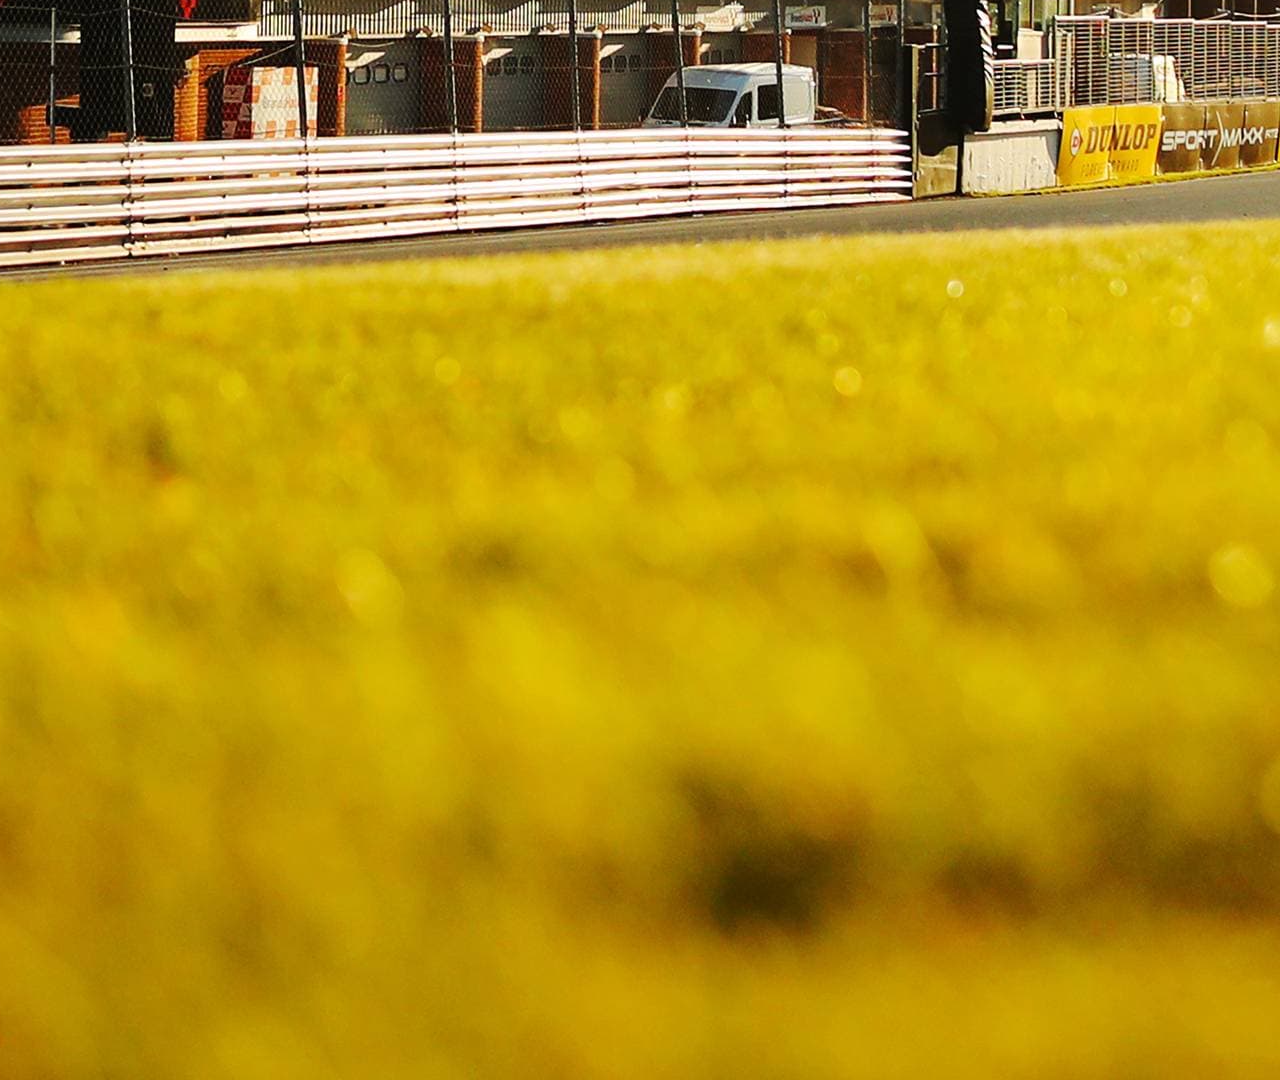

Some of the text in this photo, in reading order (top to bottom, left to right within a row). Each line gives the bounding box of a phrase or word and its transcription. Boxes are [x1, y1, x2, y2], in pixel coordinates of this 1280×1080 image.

[1084, 123, 1157, 154] DUNLOP
[1161, 128, 1218, 151] SPORT
[1223, 126, 1264, 148] MAXX
